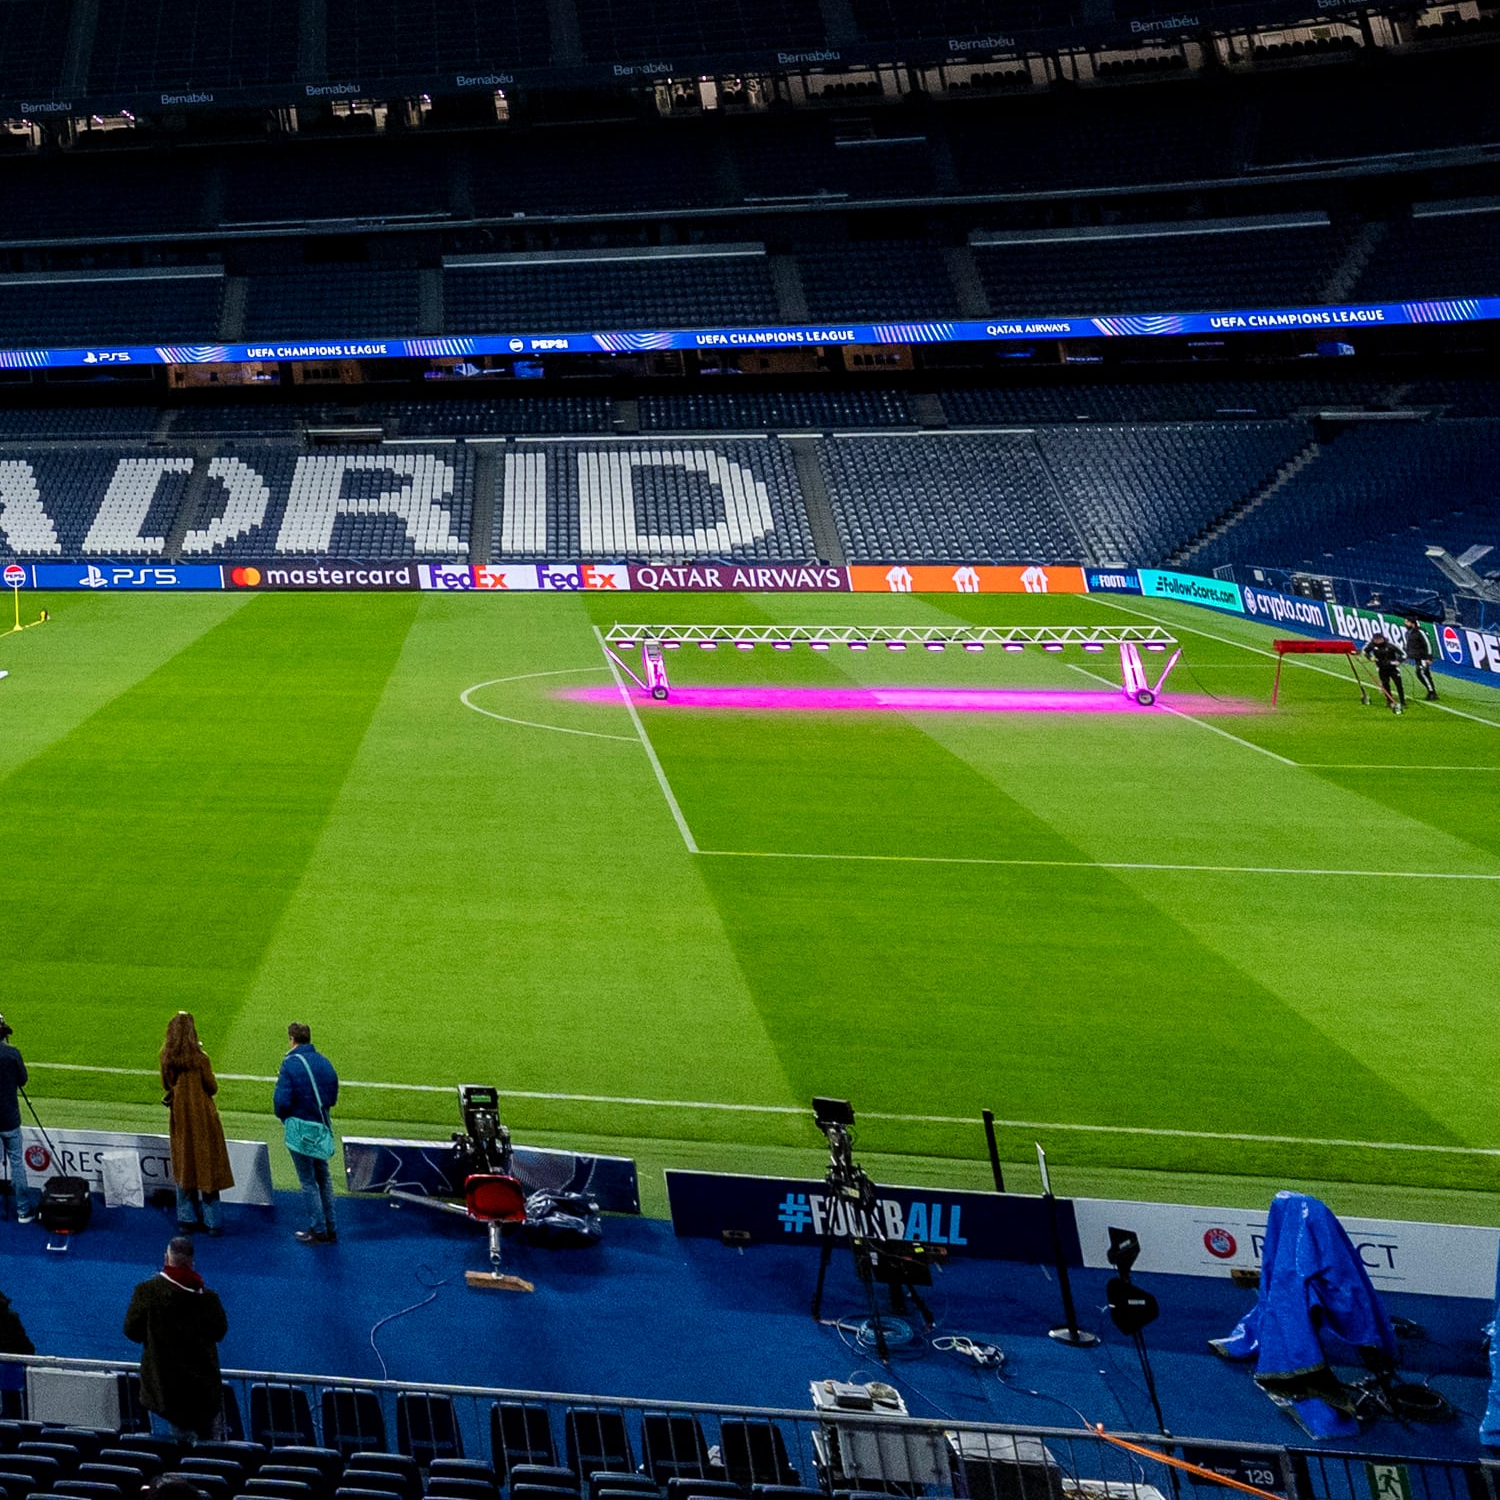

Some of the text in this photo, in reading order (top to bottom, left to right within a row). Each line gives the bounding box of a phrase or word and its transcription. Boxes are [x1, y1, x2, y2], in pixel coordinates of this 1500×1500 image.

[1130, 16, 1199, 33] Bernabéu
[948, 36, 1015, 51] Bernabéu
[777, 50, 840, 63] Bernabéu
[613, 63, 673, 75] Bernabéu
[456, 74, 514, 86] Bernabéu
[305, 83, 360, 95] Bernabéu
[161, 92, 214, 104] Bernabéu
[20, 101, 71, 113] Bernabéu
[1210, 309, 1384, 328] UEFA CHAMPIONS LEAGUE
[986, 323, 1070, 335] QATAR AIRWAYS
[531, 339, 568, 349] PEPSI
[695, 331, 855, 344] UEFA CHAMPIONS LEAGUE
[99, 353, 131, 361] PS5
[246, 345, 387, 358] UEFA CHAMPIONS LEAGUE
[111, 568, 177, 584] PS5
[267, 567, 410, 585] mastercard
[429, 565, 508, 589] FedEx
[535, 565, 617, 590] FedEx
[636, 567, 841, 590] QATAR AIRWAYS
[1091, 575, 1139, 588] #FOOTBALL
[1163, 577, 1237, 605] FollowScores.com
[1256, 596, 1325, 627] crypto.com
[61, 1150, 171, 1178] RESCT
[778, 1193, 968, 1245] #FOOBALL
[1244, 1469, 1275, 1485] 129
